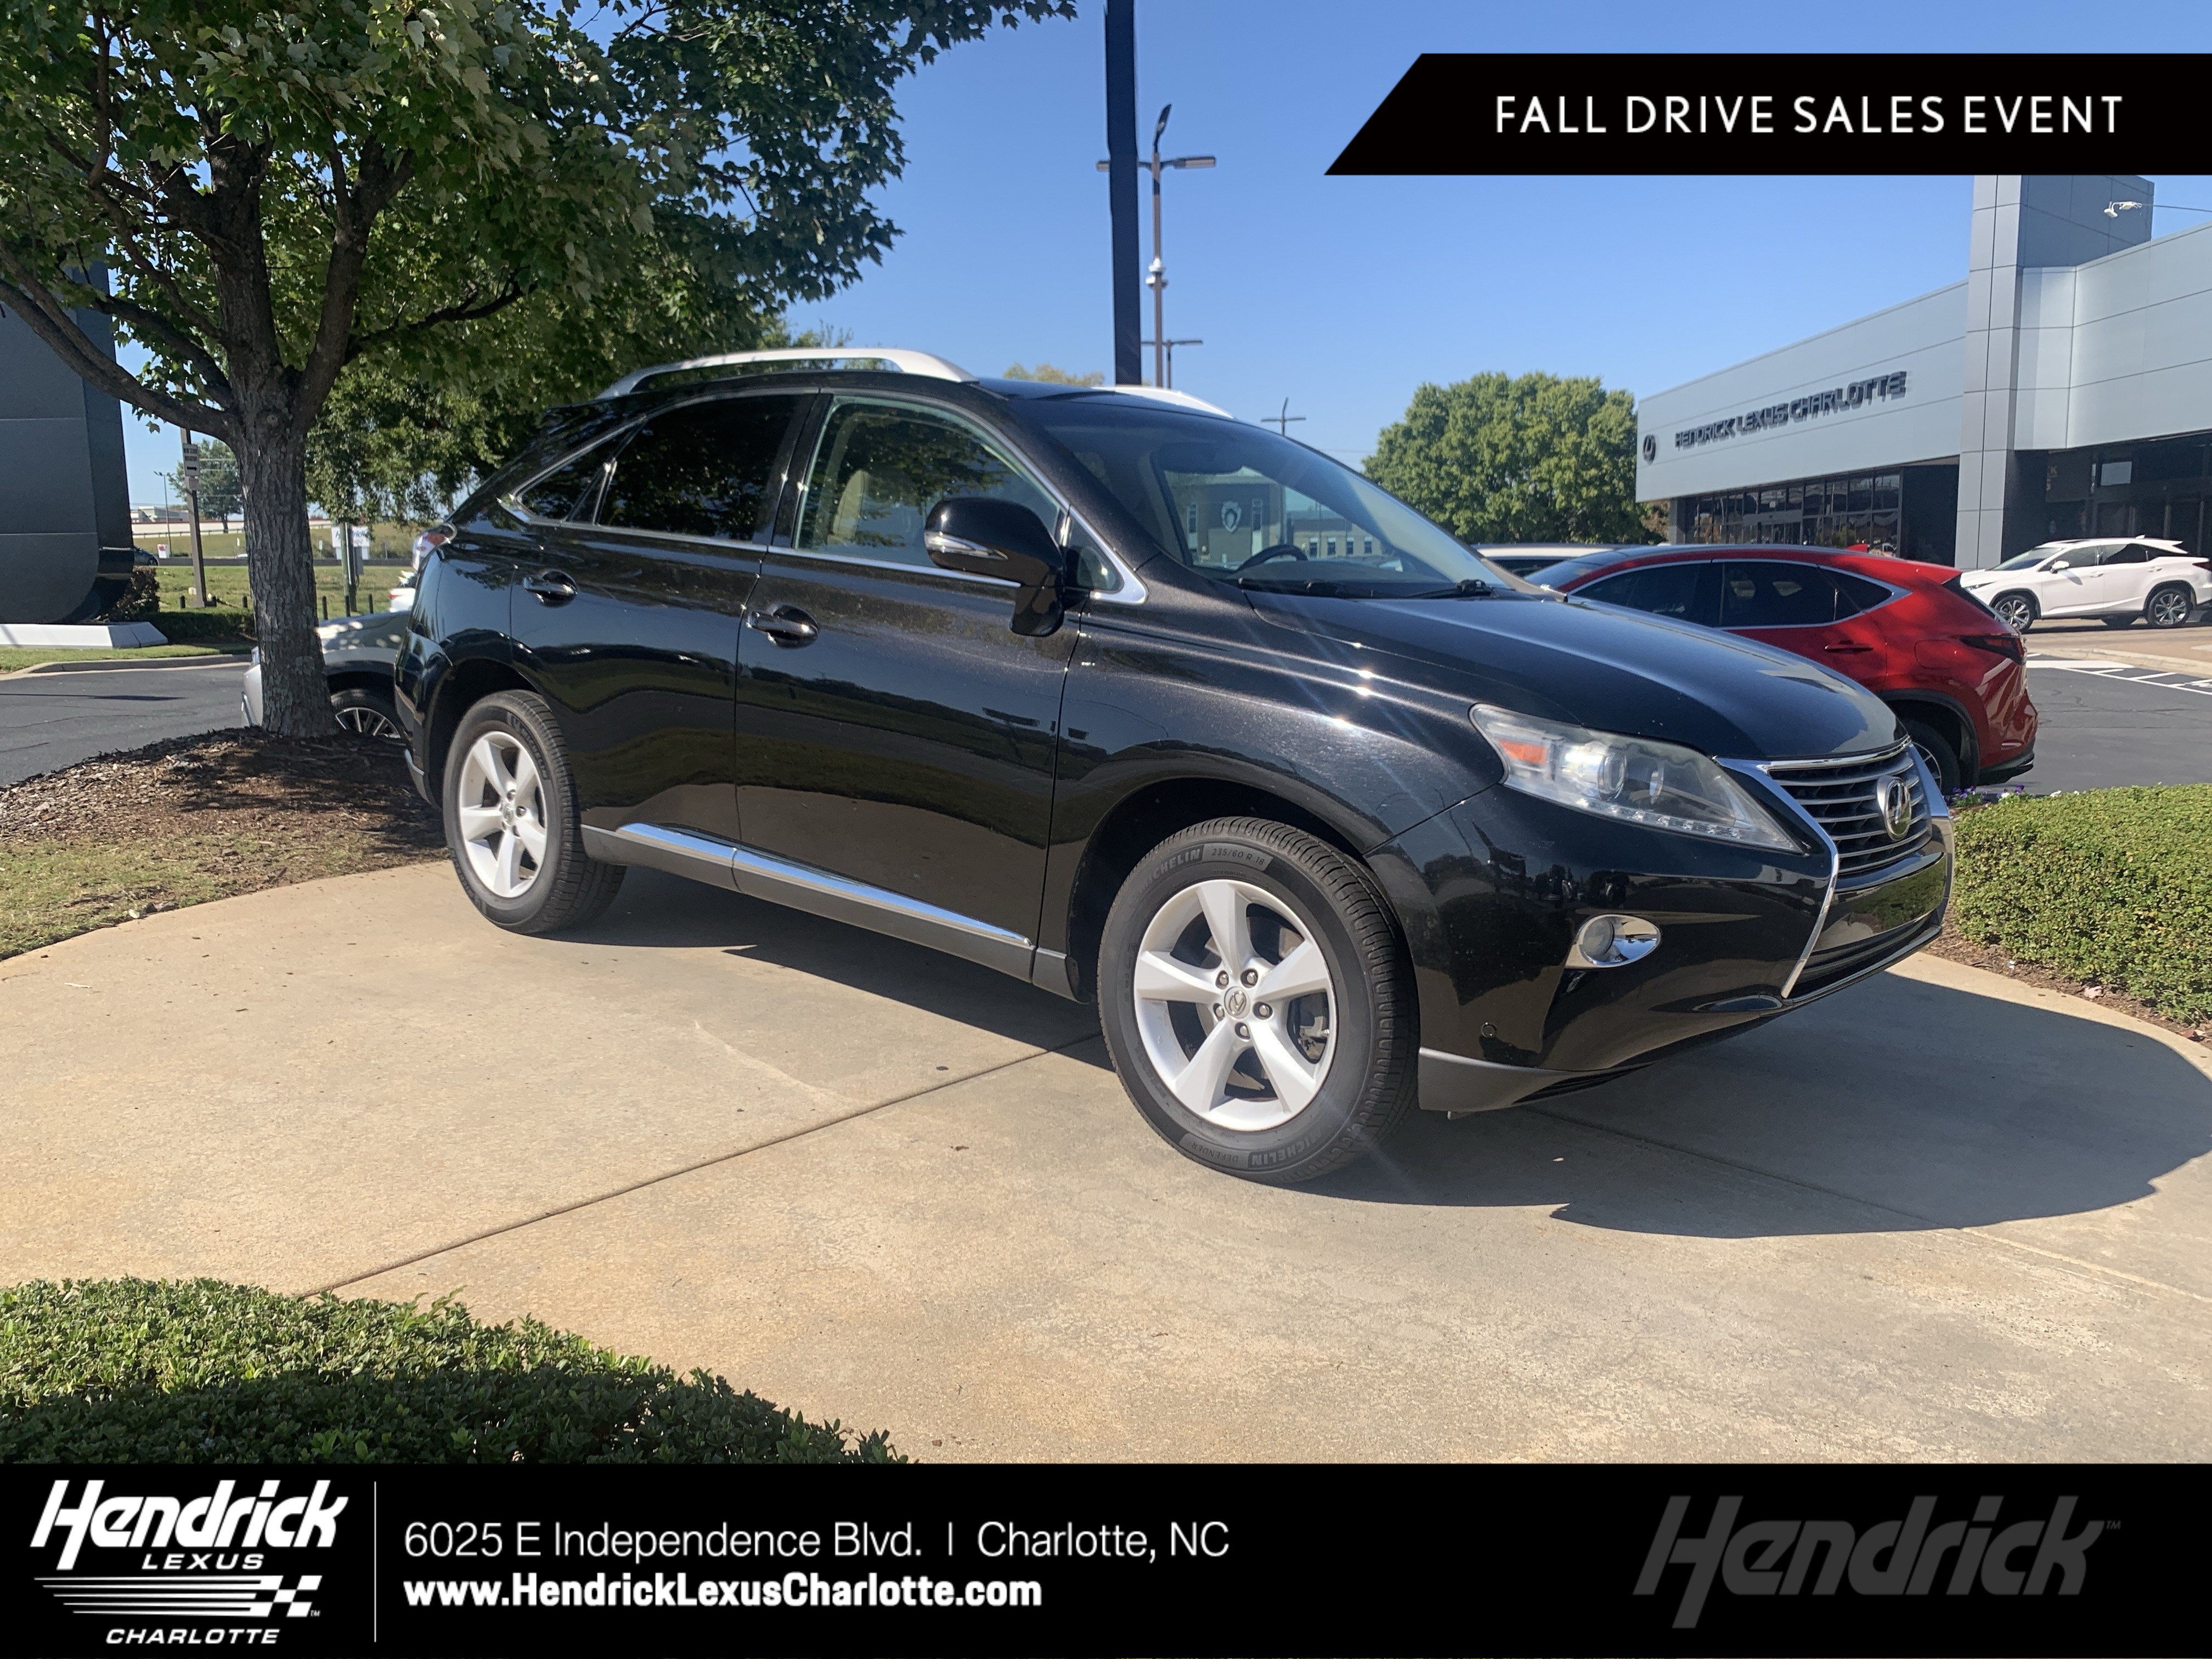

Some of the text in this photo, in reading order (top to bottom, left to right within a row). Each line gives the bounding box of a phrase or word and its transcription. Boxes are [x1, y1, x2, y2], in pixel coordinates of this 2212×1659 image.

[1736, 403, 1788, 435] LEXUS
[1789, 371, 1906, 422] CHARLOTTE
[1211, 848, 1244, 859] 235/60
[1255, 856, 1265, 865] 18
